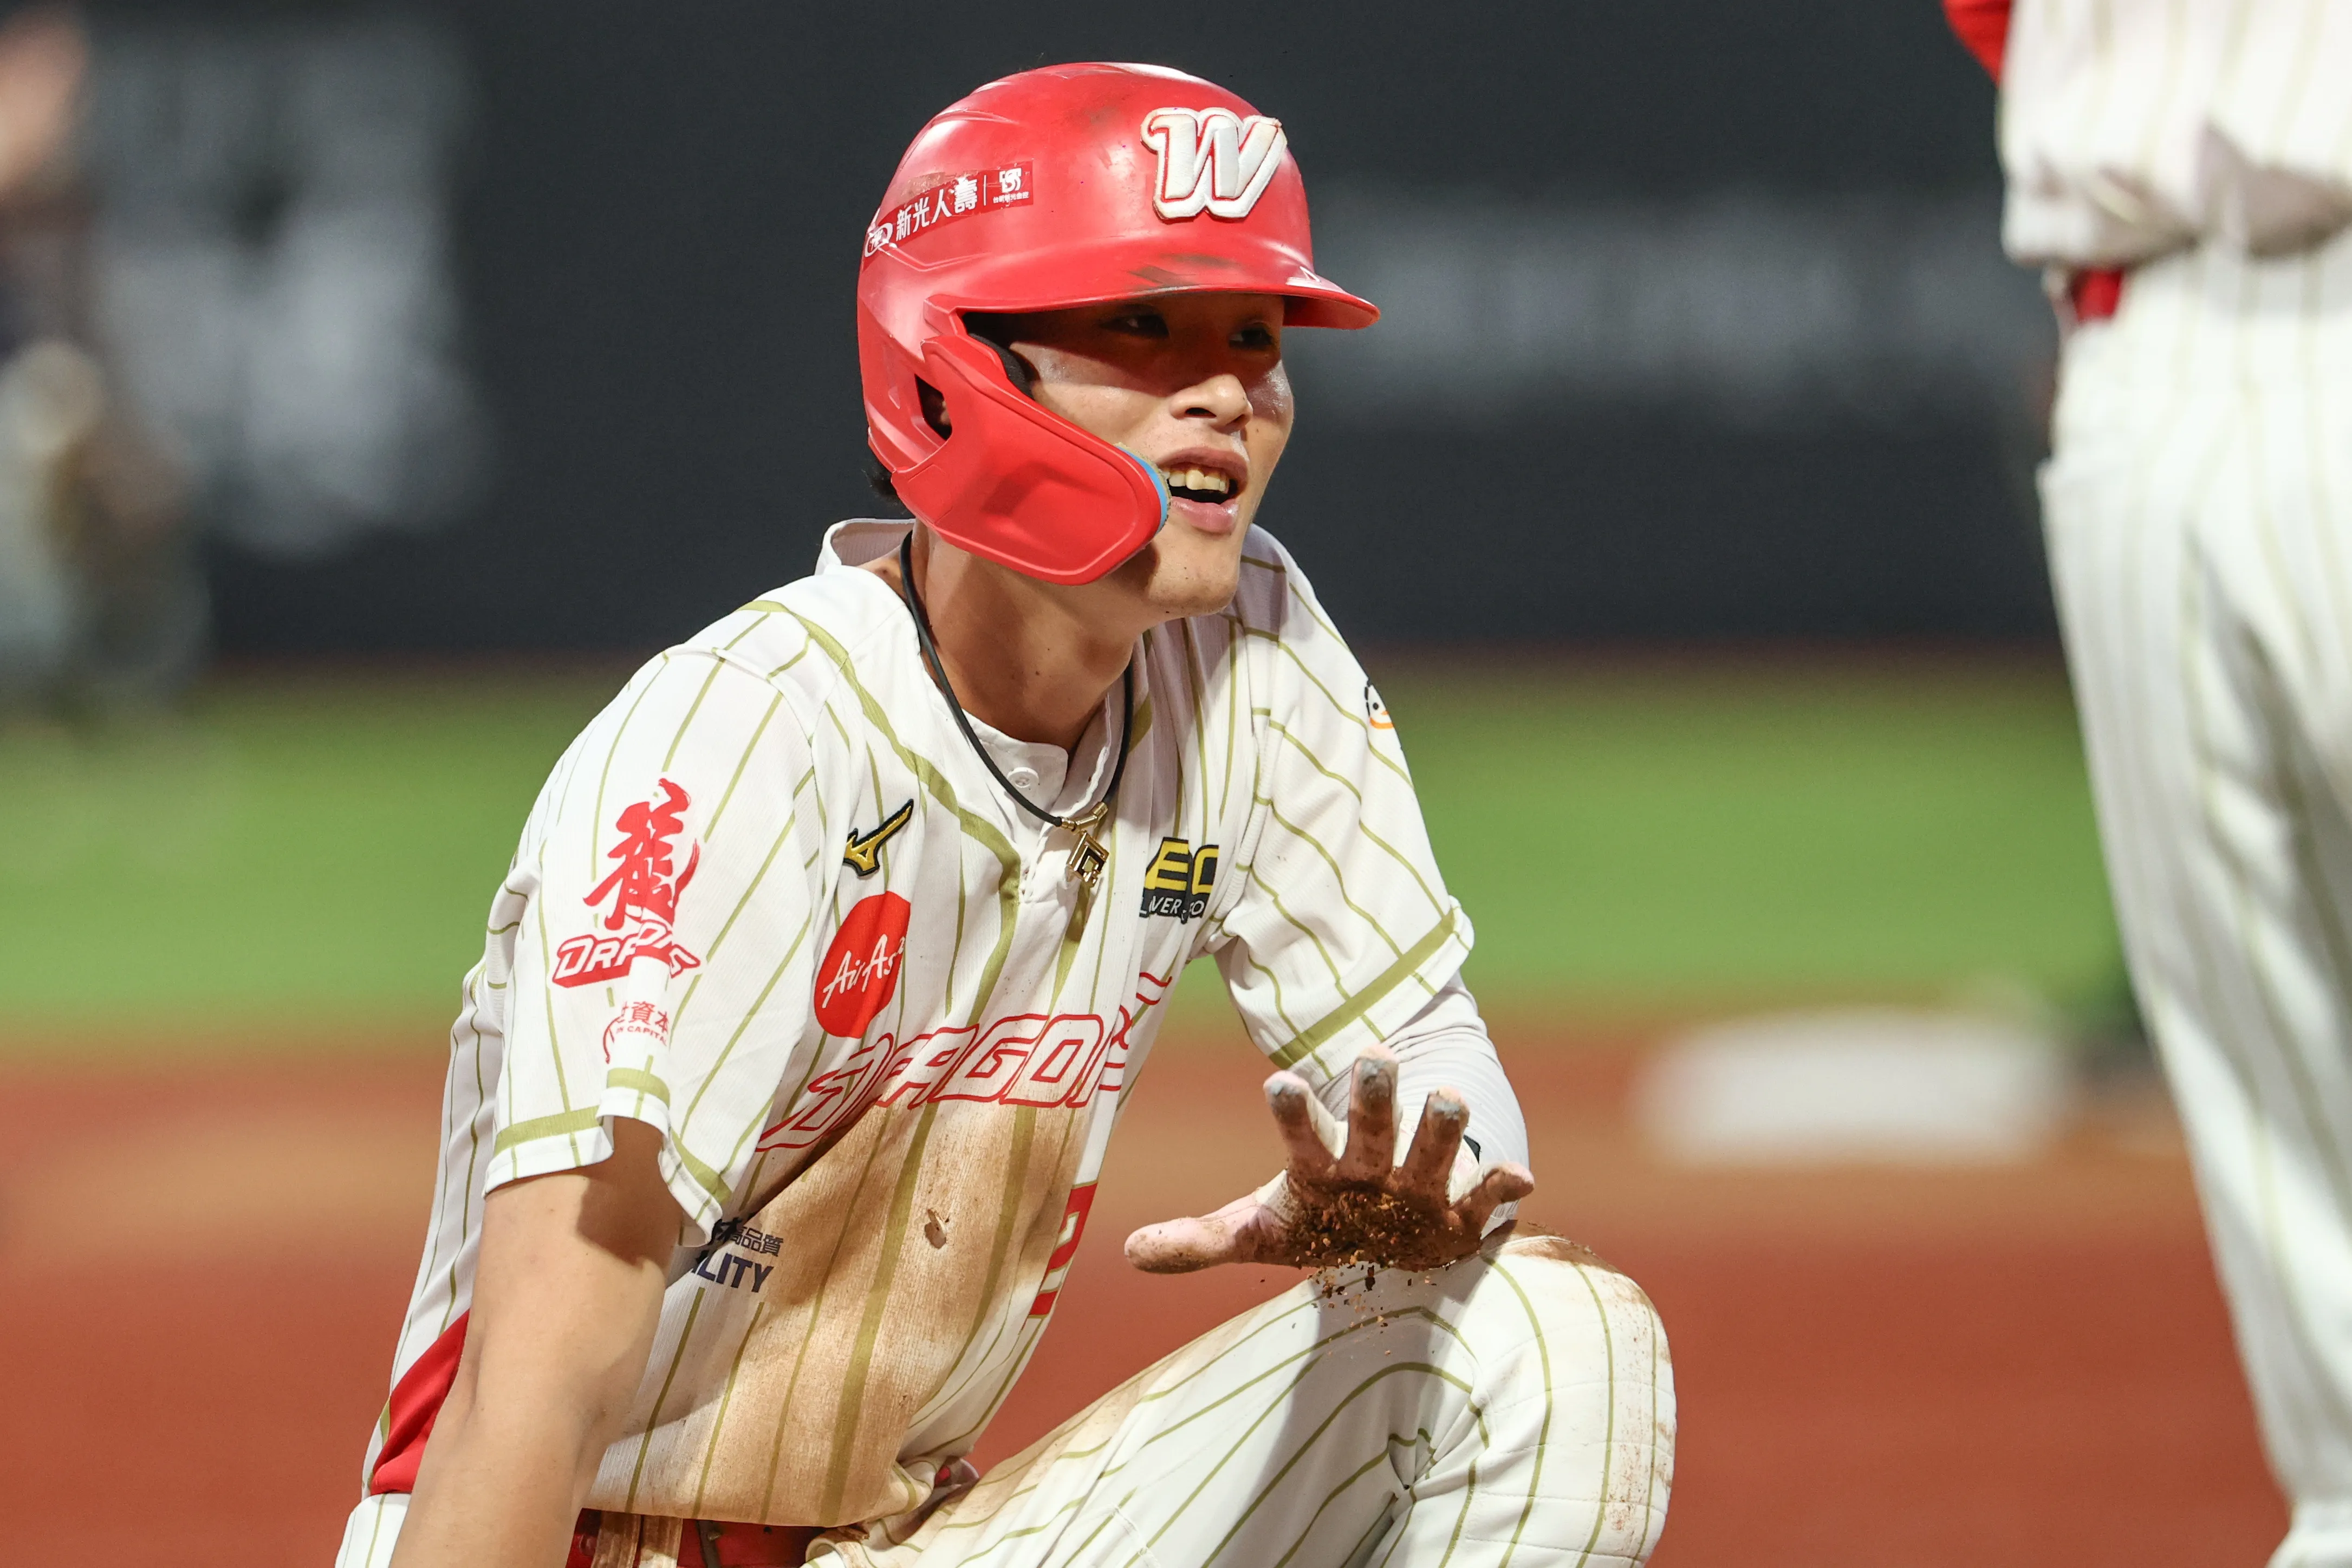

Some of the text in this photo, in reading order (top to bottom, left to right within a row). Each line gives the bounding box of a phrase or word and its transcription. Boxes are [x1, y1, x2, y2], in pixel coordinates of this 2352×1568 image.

[1140, 107, 1288, 219] W
[895, 176, 978, 242] 新光人壽
[627, 1025, 667, 1047] CAPITA
[691, 1252, 775, 1293] LITY
